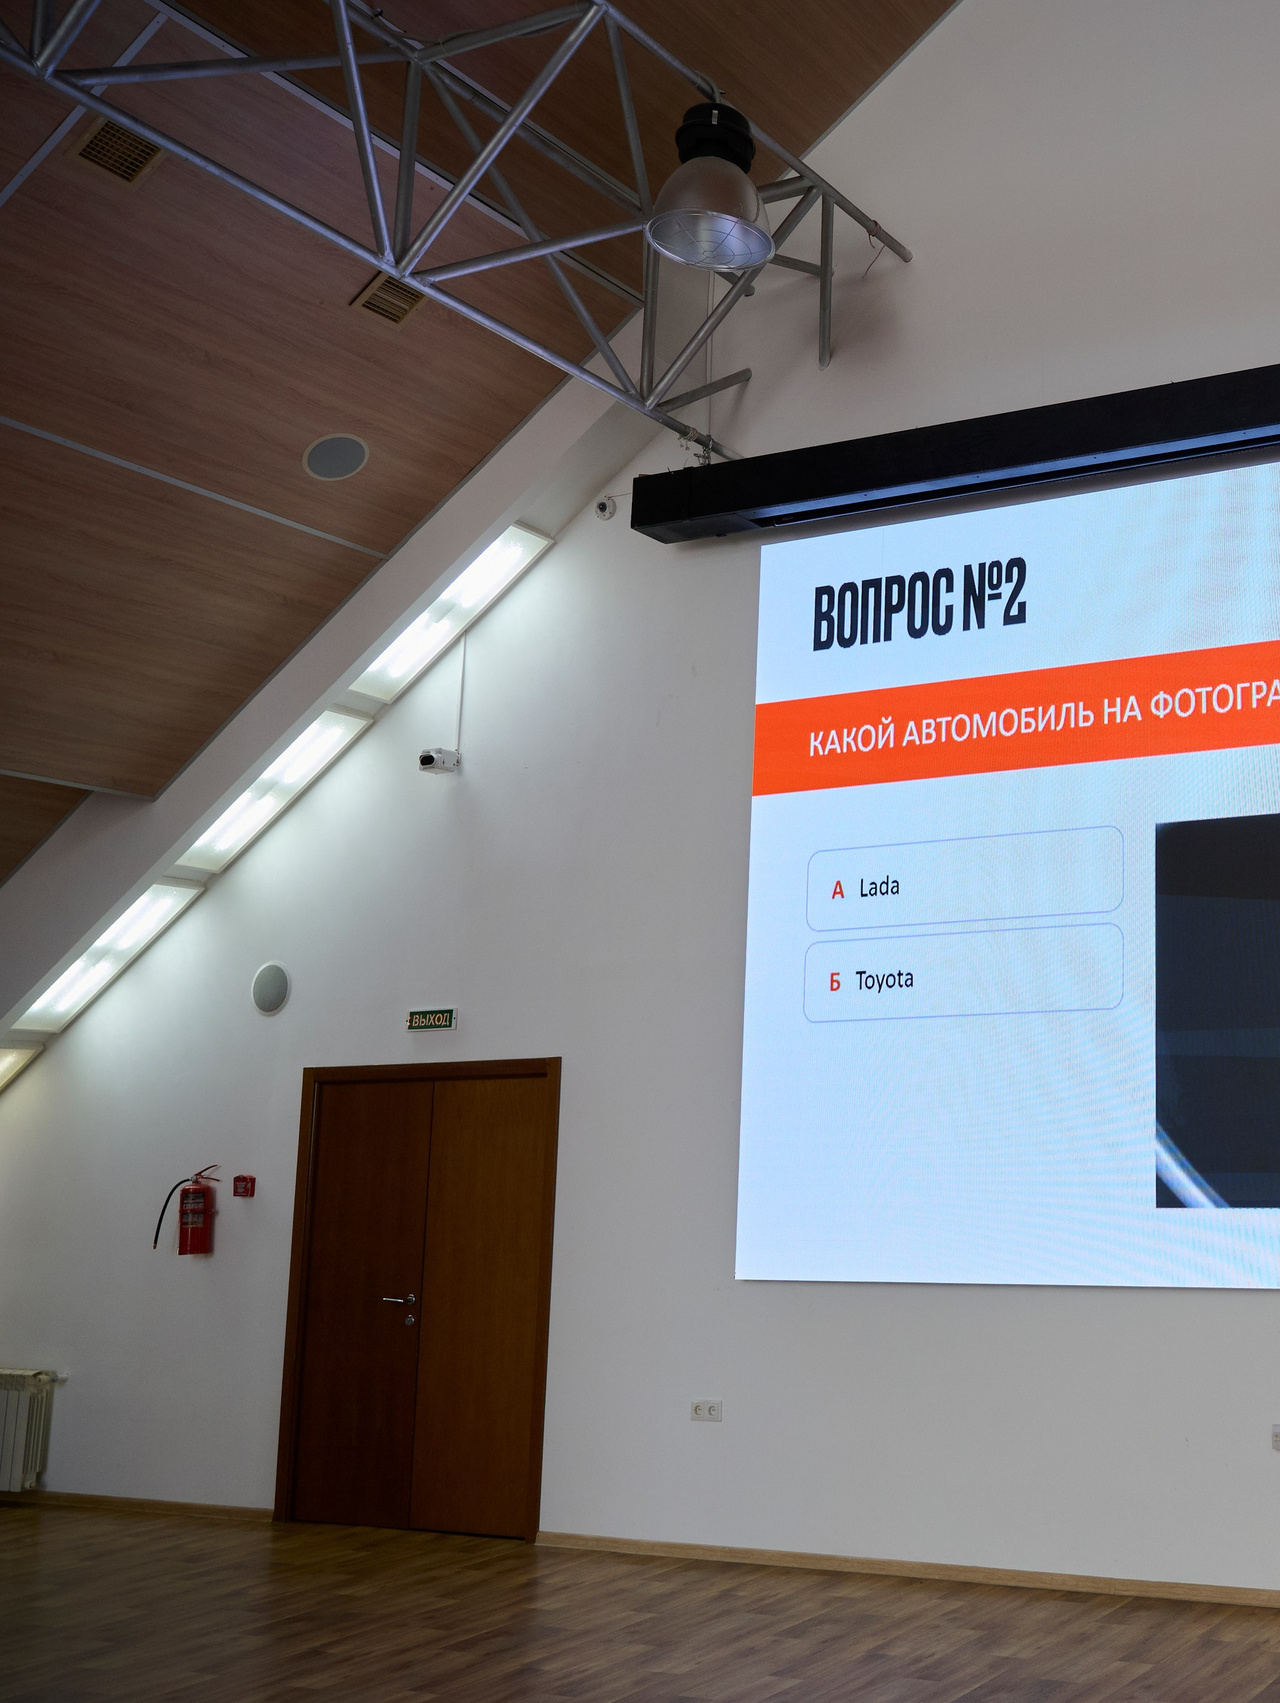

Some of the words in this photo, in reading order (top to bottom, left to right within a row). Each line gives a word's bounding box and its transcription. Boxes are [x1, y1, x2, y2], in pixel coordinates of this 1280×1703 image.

[813, 567, 954, 652] ВОПРОС
[962, 556, 1027, 632] №2
[809, 716, 895, 757] КАКОЙ
[902, 701, 1095, 747] АВТОМОБИЛЬ
[1103, 695, 1142, 724] НА
[860, 875, 900, 898] Lada
[830, 972, 841, 992] Б
[855, 970, 914, 994] Toyota
[412, 1013, 450, 1027] ВЫХОД
